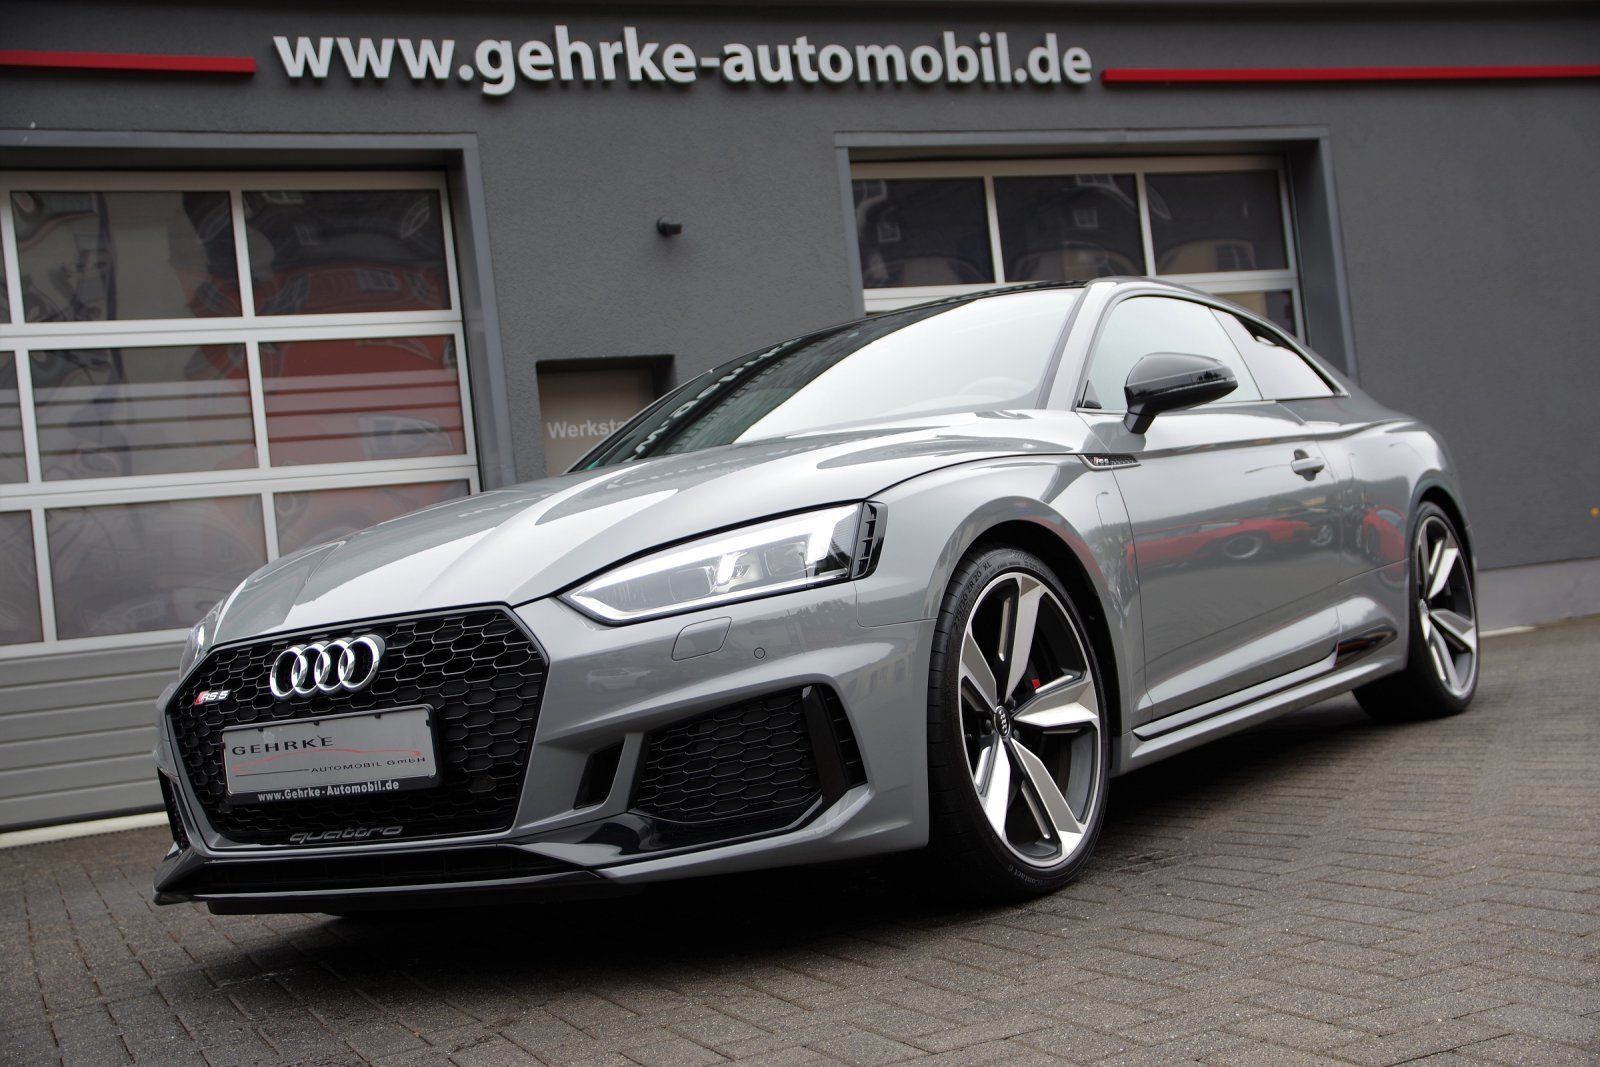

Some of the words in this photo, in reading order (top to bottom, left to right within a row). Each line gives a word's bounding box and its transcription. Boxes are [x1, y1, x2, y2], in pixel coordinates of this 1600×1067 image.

[272, 25, 1092, 96] www.gehrke-automobil.de
[982, 561, 992, 571] XL
[232, 736, 334, 756] GEHRKE
[311, 761, 383, 774] AUTOMOBIL
[386, 756, 426, 767] GmbH
[258, 780, 400, 802] www.Gehrke-Automobil.de
[290, 825, 404, 845] quattro
